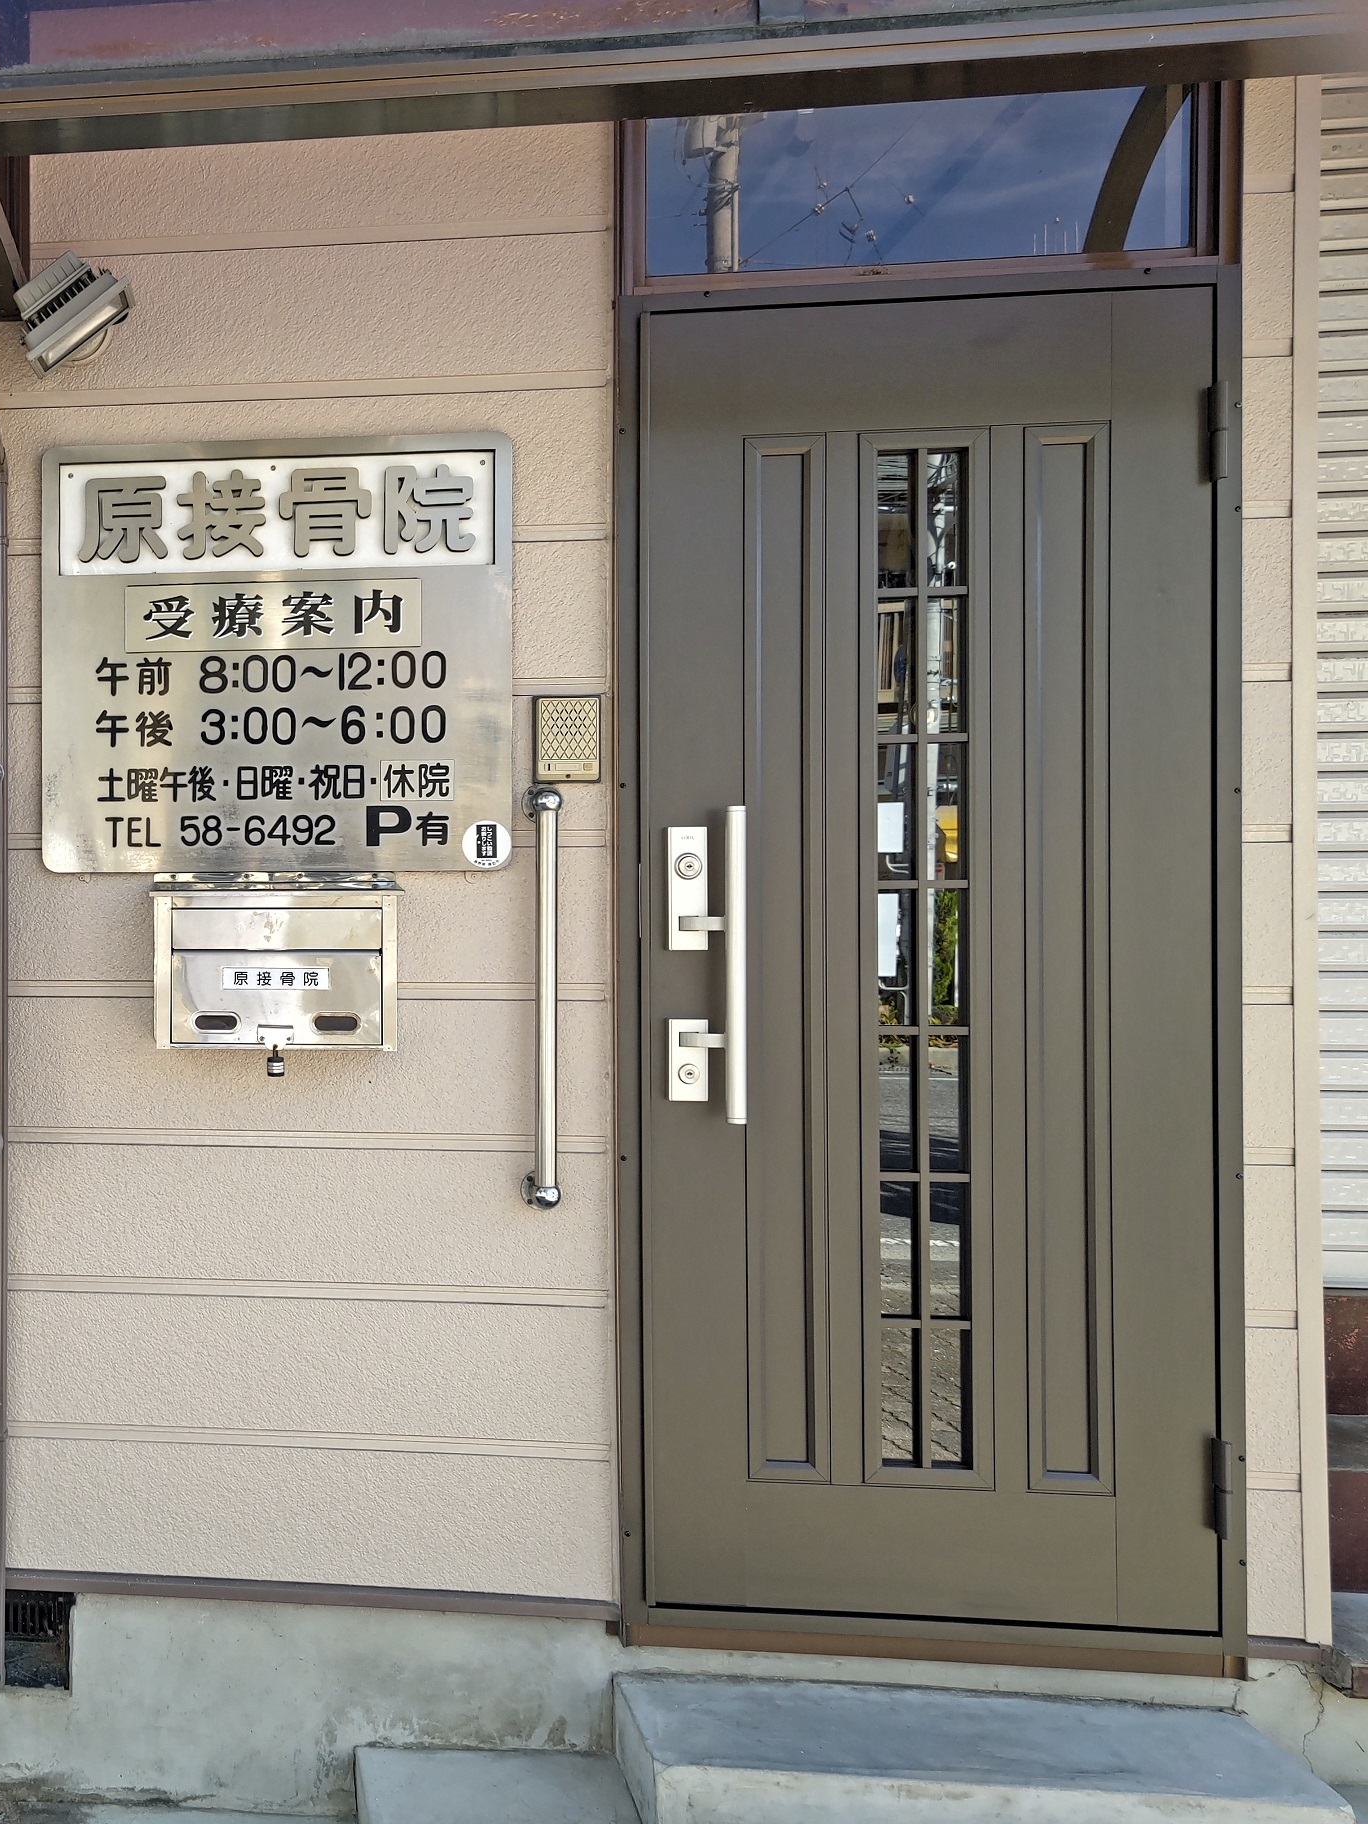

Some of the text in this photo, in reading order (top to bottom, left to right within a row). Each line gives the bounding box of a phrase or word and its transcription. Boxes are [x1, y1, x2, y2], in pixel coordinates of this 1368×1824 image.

[78, 464, 477, 564] 原接骨院
[142, 589, 405, 642] 受療案内
[95, 656, 173, 697] 午前
[95, 709, 174, 748] 午後
[105, 816, 162, 848] TEL
[180, 814, 337, 848] 58-6492
[233, 971, 320, 987] 原接骨院
